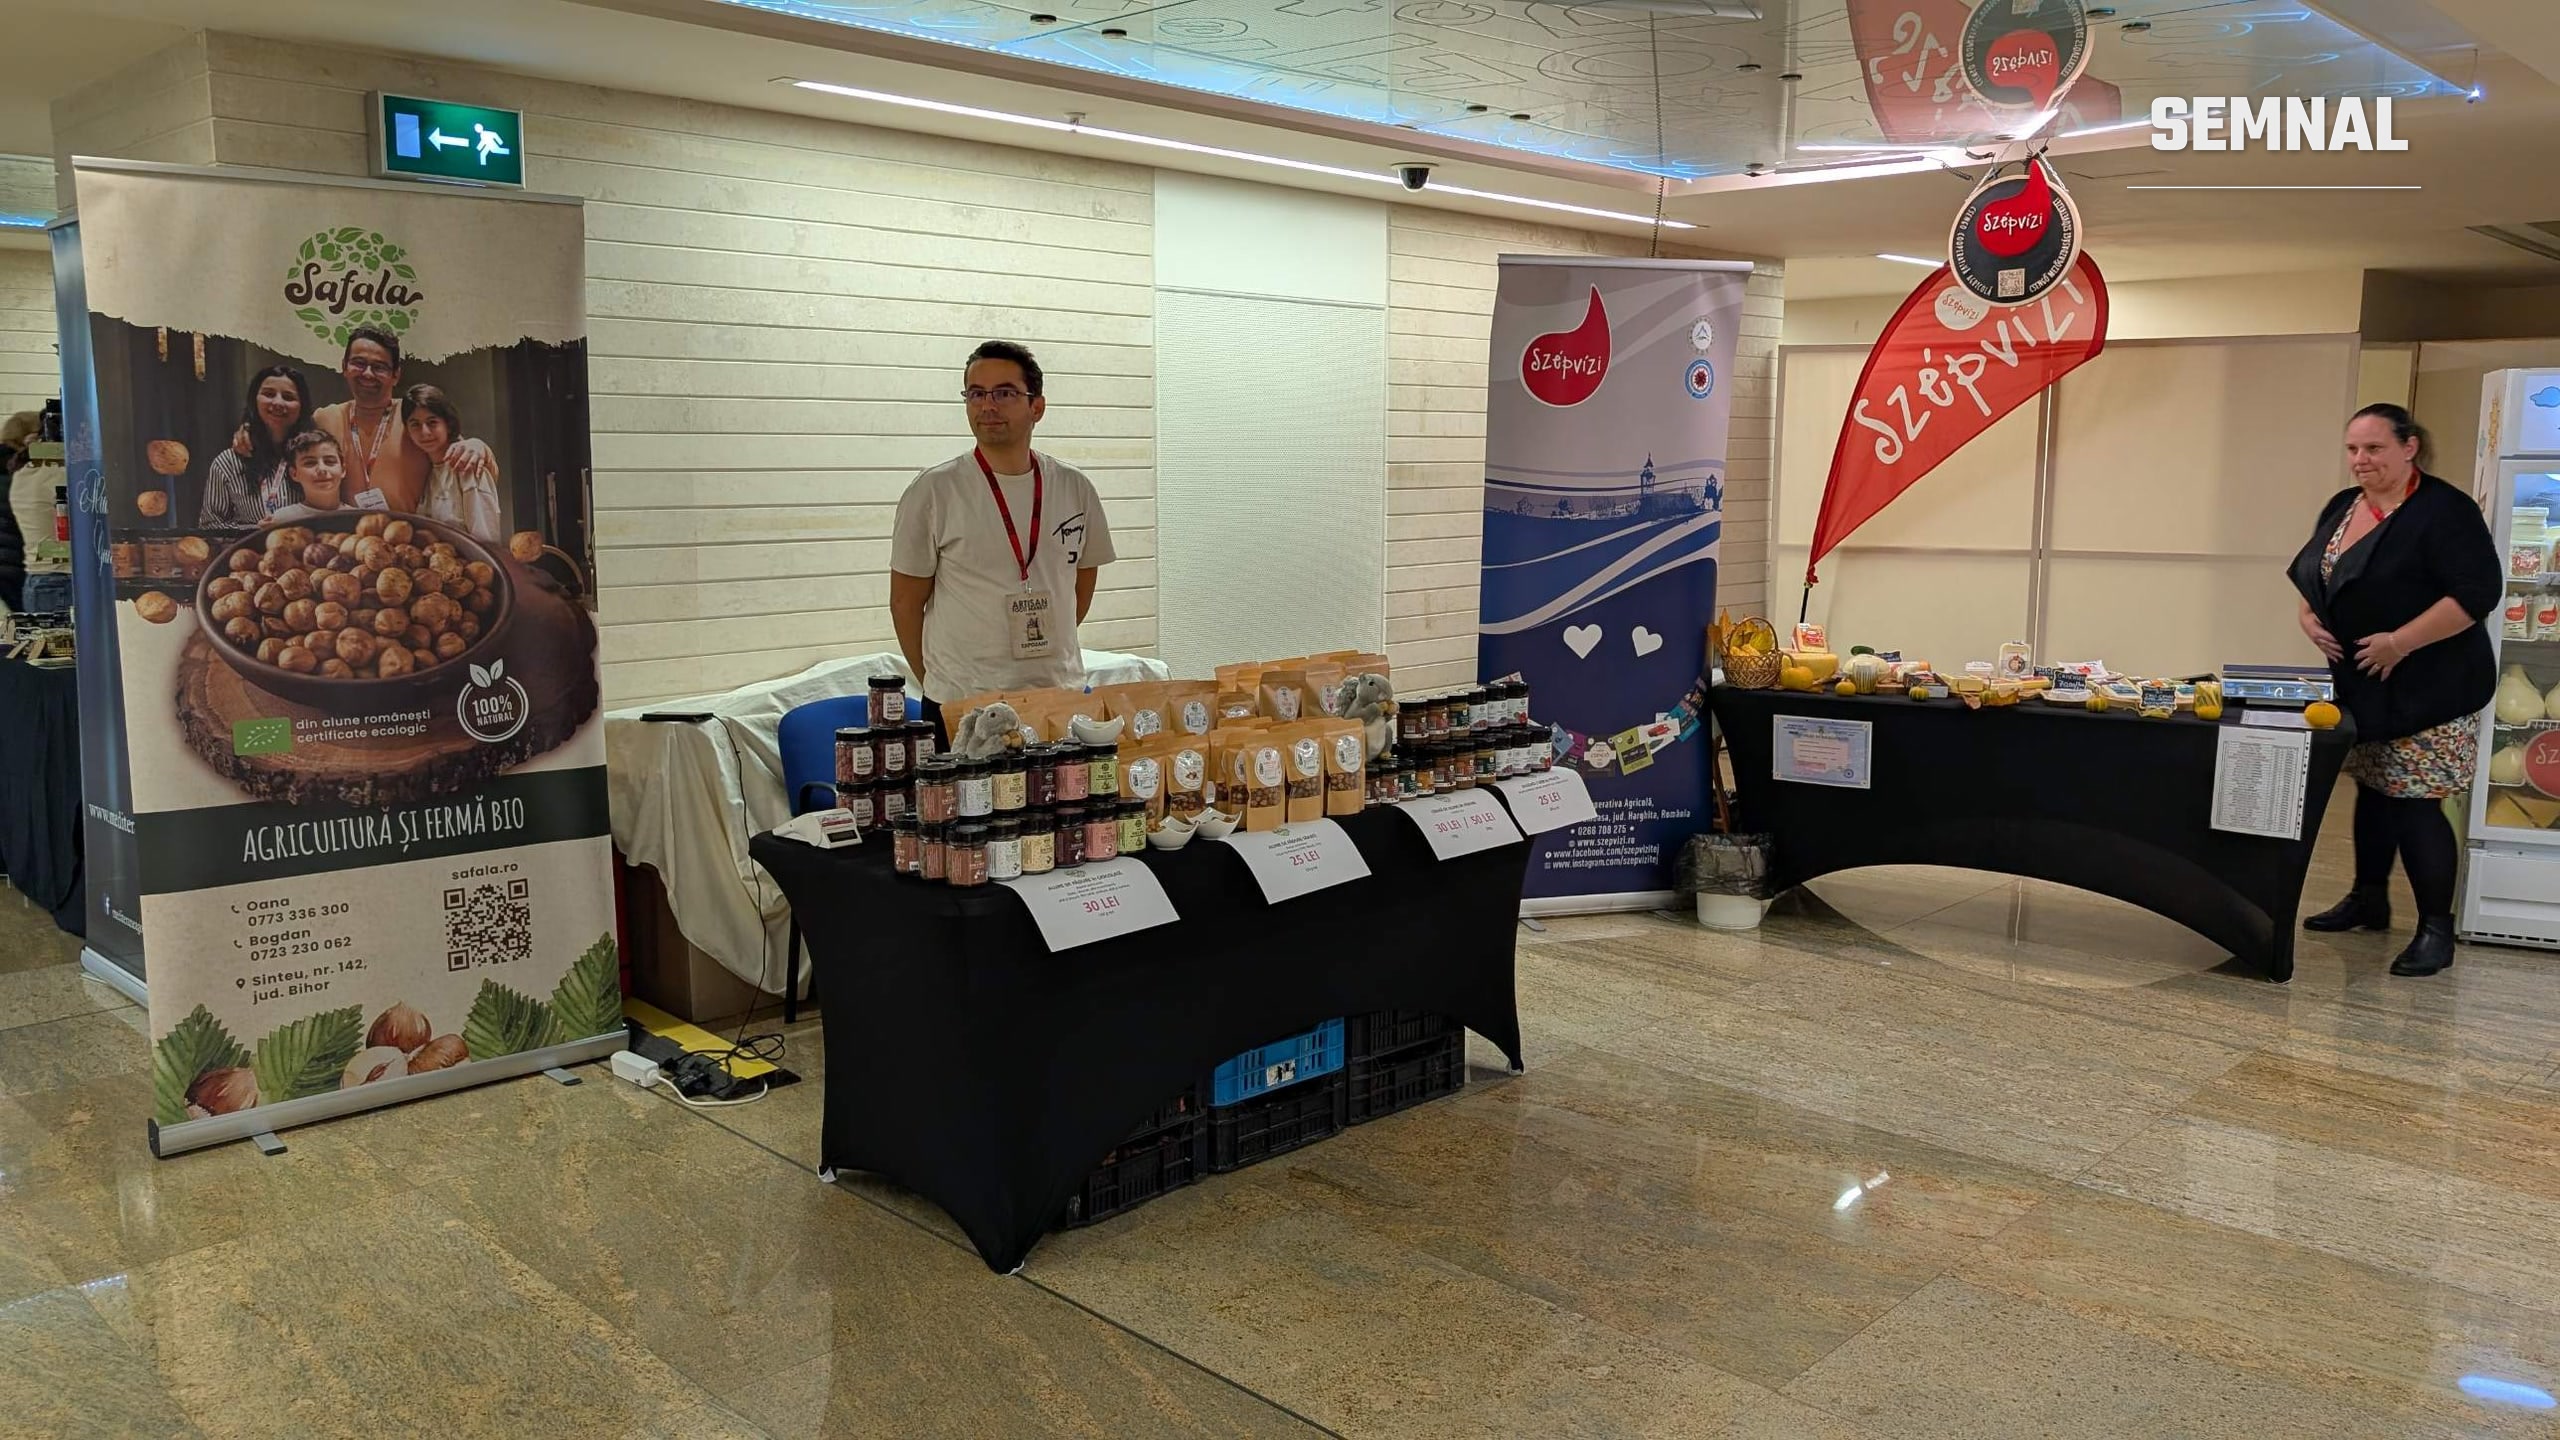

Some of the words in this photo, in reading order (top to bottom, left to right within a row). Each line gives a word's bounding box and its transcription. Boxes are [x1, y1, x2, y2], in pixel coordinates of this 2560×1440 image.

[1983, 211, 2043, 236] Szépvízi
[285, 262, 424, 314] Safala
[1530, 348, 1602, 380] Szépvízi
[472, 694, 513, 717] 100%
[296, 719, 319, 730] din
[322, 716, 360, 729] alune
[477, 711, 515, 726] NATURAL
[297, 729, 367, 744] certificate
[371, 723, 427, 739] ecologic
[244, 806, 393, 862] AGRICULTURĂ
[399, 810, 419, 854] ȘI
[426, 794, 486, 841] FERMĂ
[491, 797, 525, 831] BIO
[1289, 855, 1304, 866] 25
[1304, 850, 1321, 862] LEI
[451, 862, 519, 880] safala.ro
[247, 898, 290, 912] Oana
[248, 913, 284, 927] 0773
[289, 908, 317, 921] 336
[321, 902, 350, 916] 300
[1083, 900, 1100, 913] 30
[1100, 895, 1120, 909] LEI
[249, 927, 311, 947] Bogdan
[251, 947, 287, 962] 0723
[292, 941, 319, 956] 230
[324, 936, 352, 950] 062
[252, 970, 309, 987] Sinteu,
[313, 963, 334, 977] nr.
[338, 958, 368, 973] 142,
[252, 987, 285, 1005] jud.
[289, 979, 330, 996] Bihor
